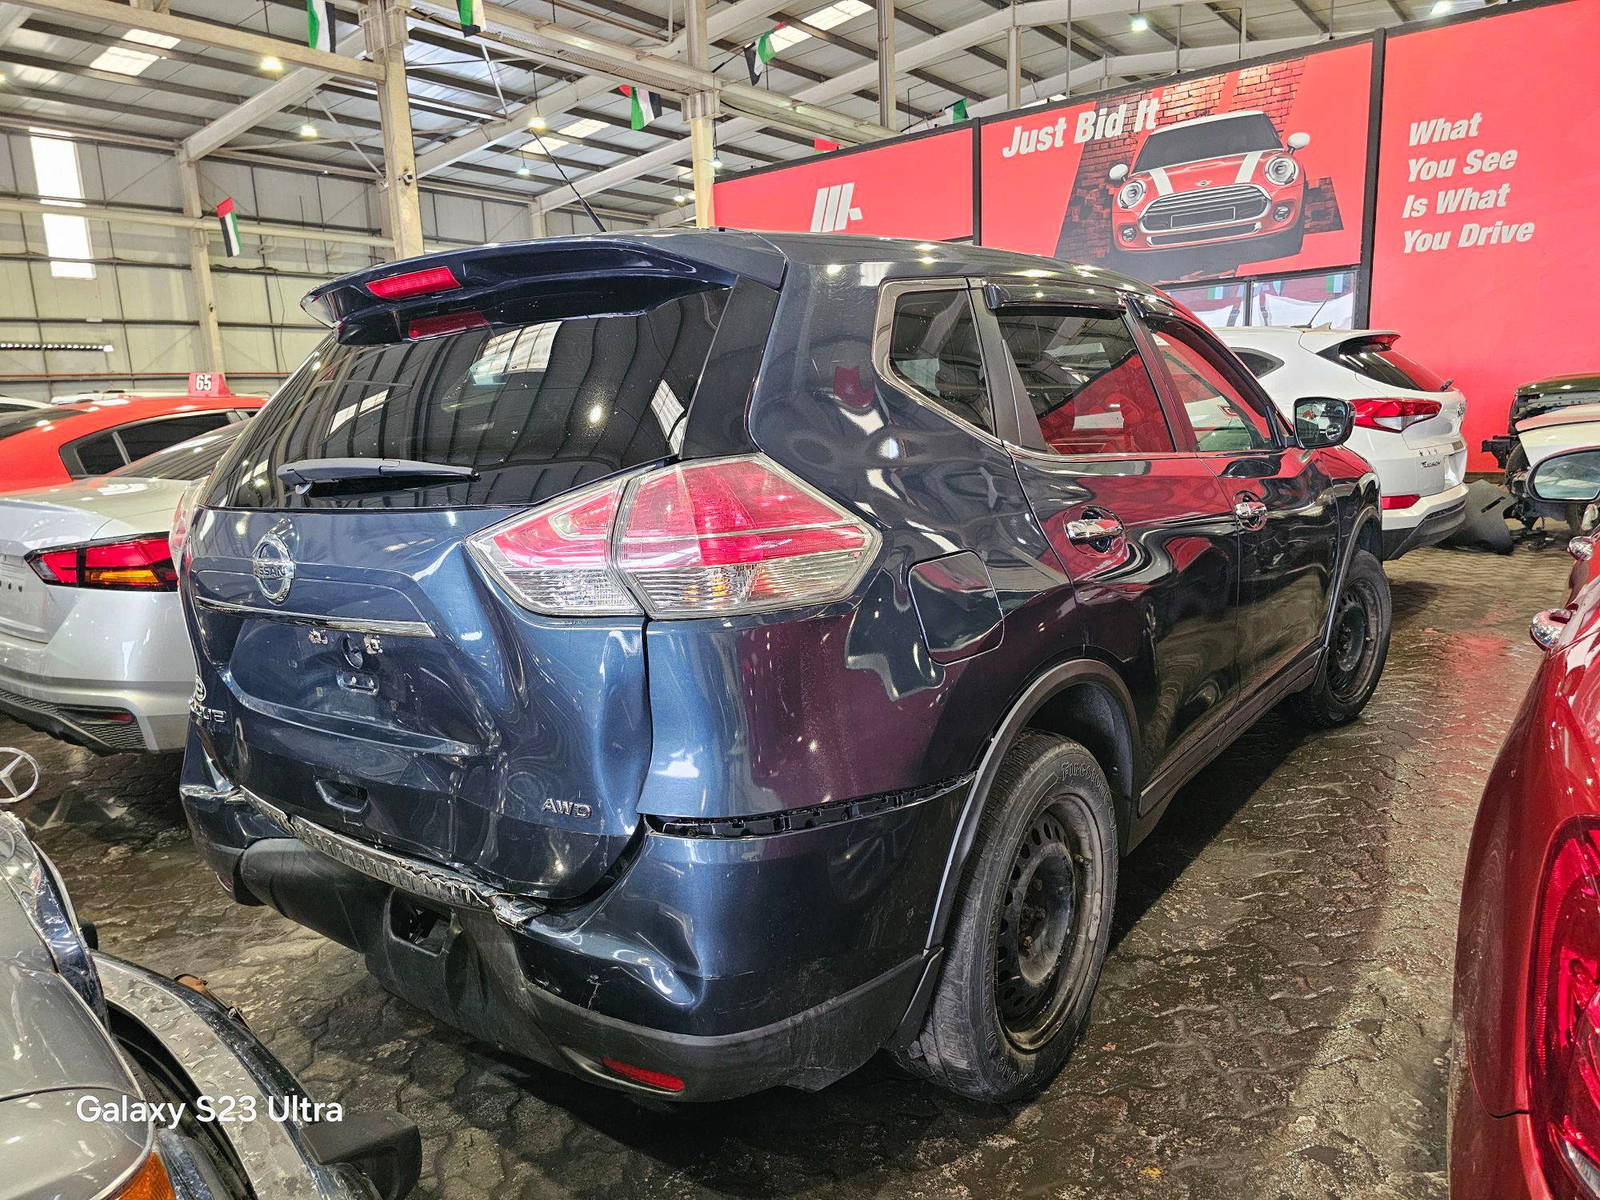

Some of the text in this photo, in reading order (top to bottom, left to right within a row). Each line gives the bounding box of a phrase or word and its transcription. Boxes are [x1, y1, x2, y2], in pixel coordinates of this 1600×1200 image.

[1002, 97, 1161, 158] Just Bid It
[1409, 112, 1483, 147] What
[1408, 149, 1518, 182] You See
[1401, 183, 1511, 218] Is What
[1403, 220, 1535, 253] You Drive
[196, 374, 212, 391] 65
[253, 562, 287, 578] SSAN
[542, 797, 592, 819] AWD
